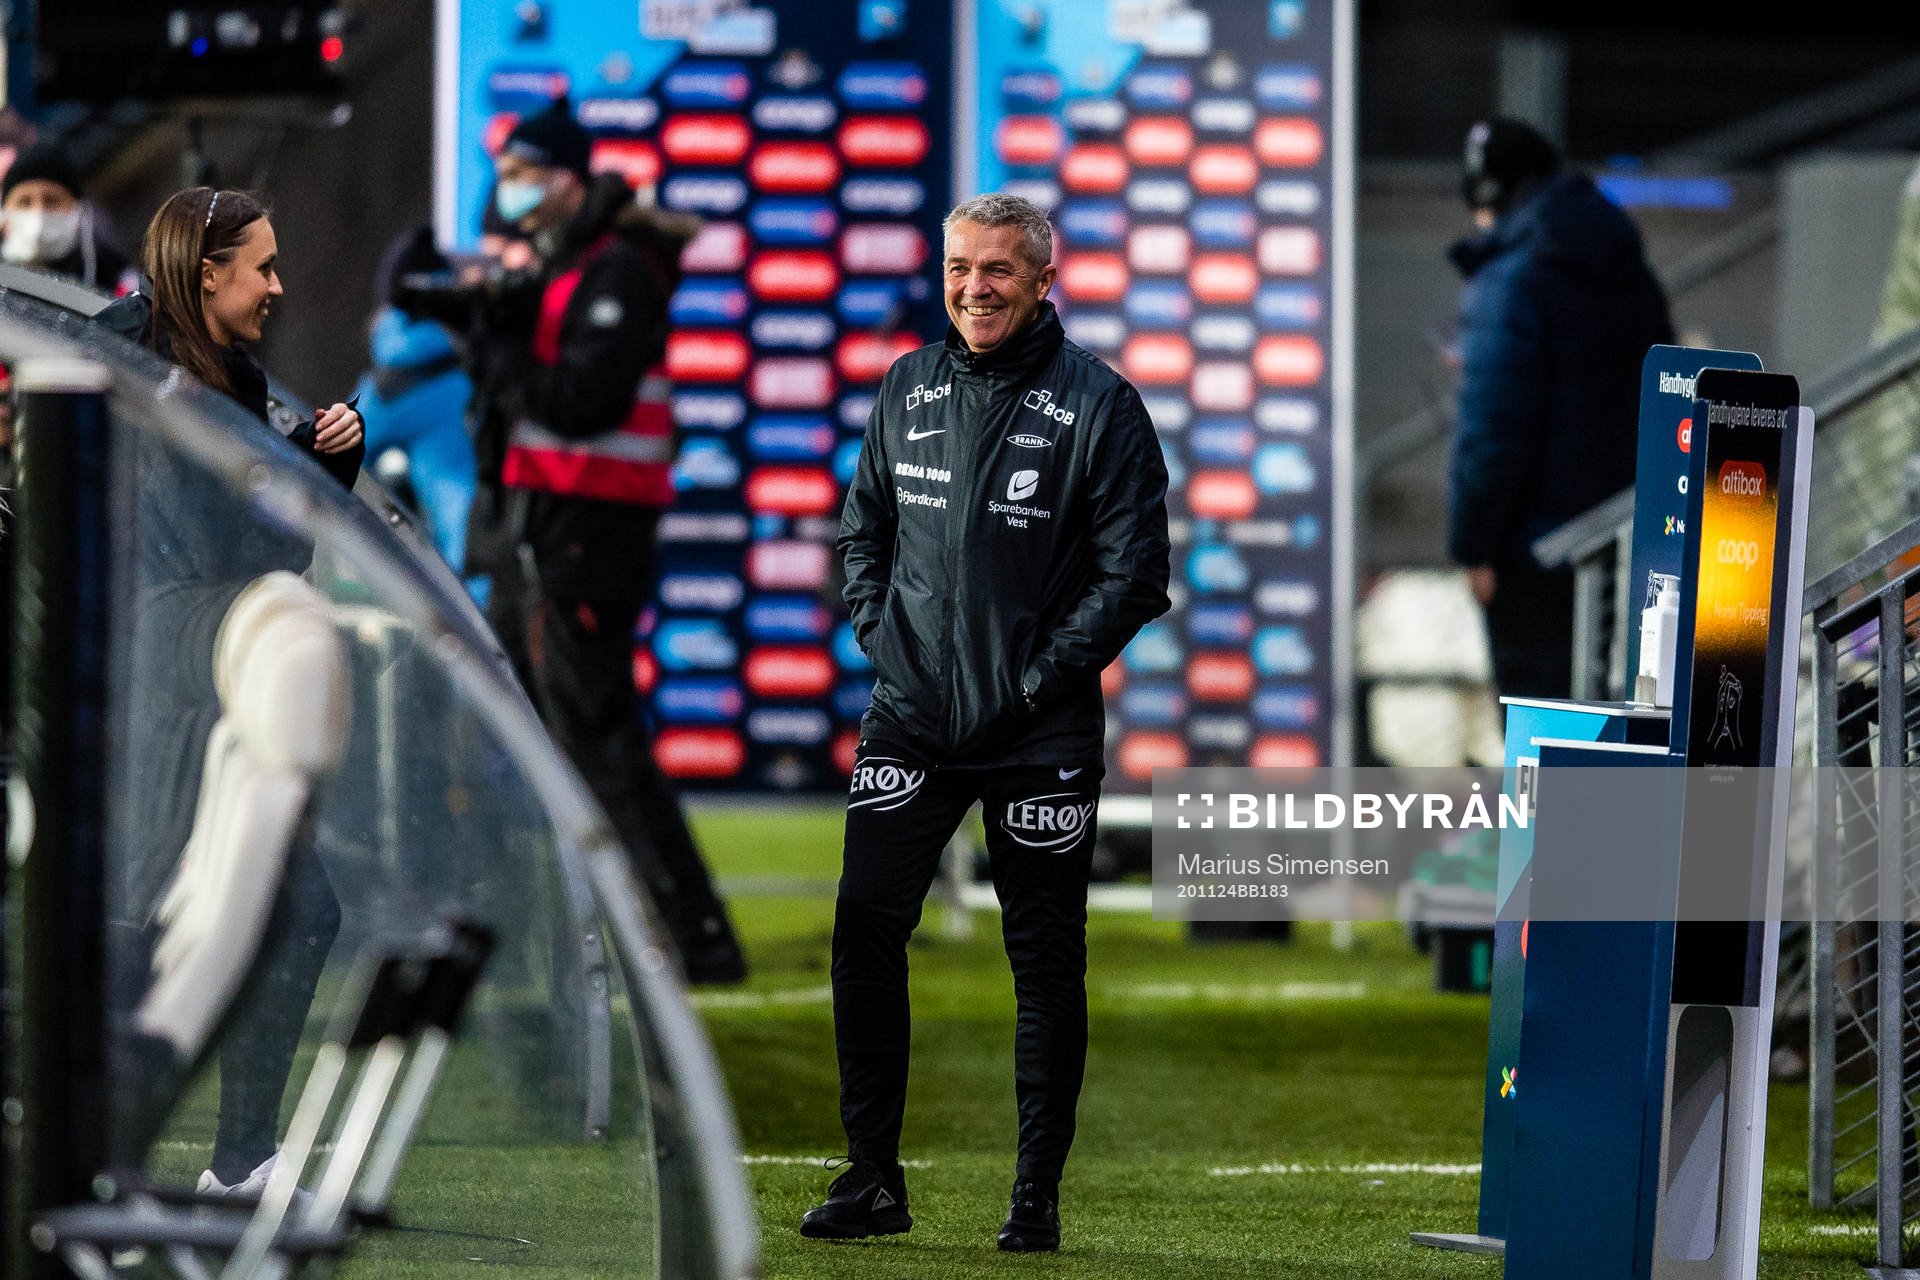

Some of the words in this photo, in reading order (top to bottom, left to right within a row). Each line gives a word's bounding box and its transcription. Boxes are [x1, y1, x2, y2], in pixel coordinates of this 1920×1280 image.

[923, 382, 952, 403] BOB
[1043, 402, 1075, 426] BOB
[1015, 436, 1043, 447] BRANN
[895, 462, 925, 479] REMA
[926, 467, 951, 483] 1000
[1722, 468, 1762, 496] altibox
[903, 490, 948, 510] Fjordkraft
[988, 500, 1050, 519] Sparebanken
[1006, 515, 1029, 529] Vest
[1717, 538, 1759, 572] coop
[850, 765, 918, 794] ERØY
[1006, 802, 1092, 831] LERØY
